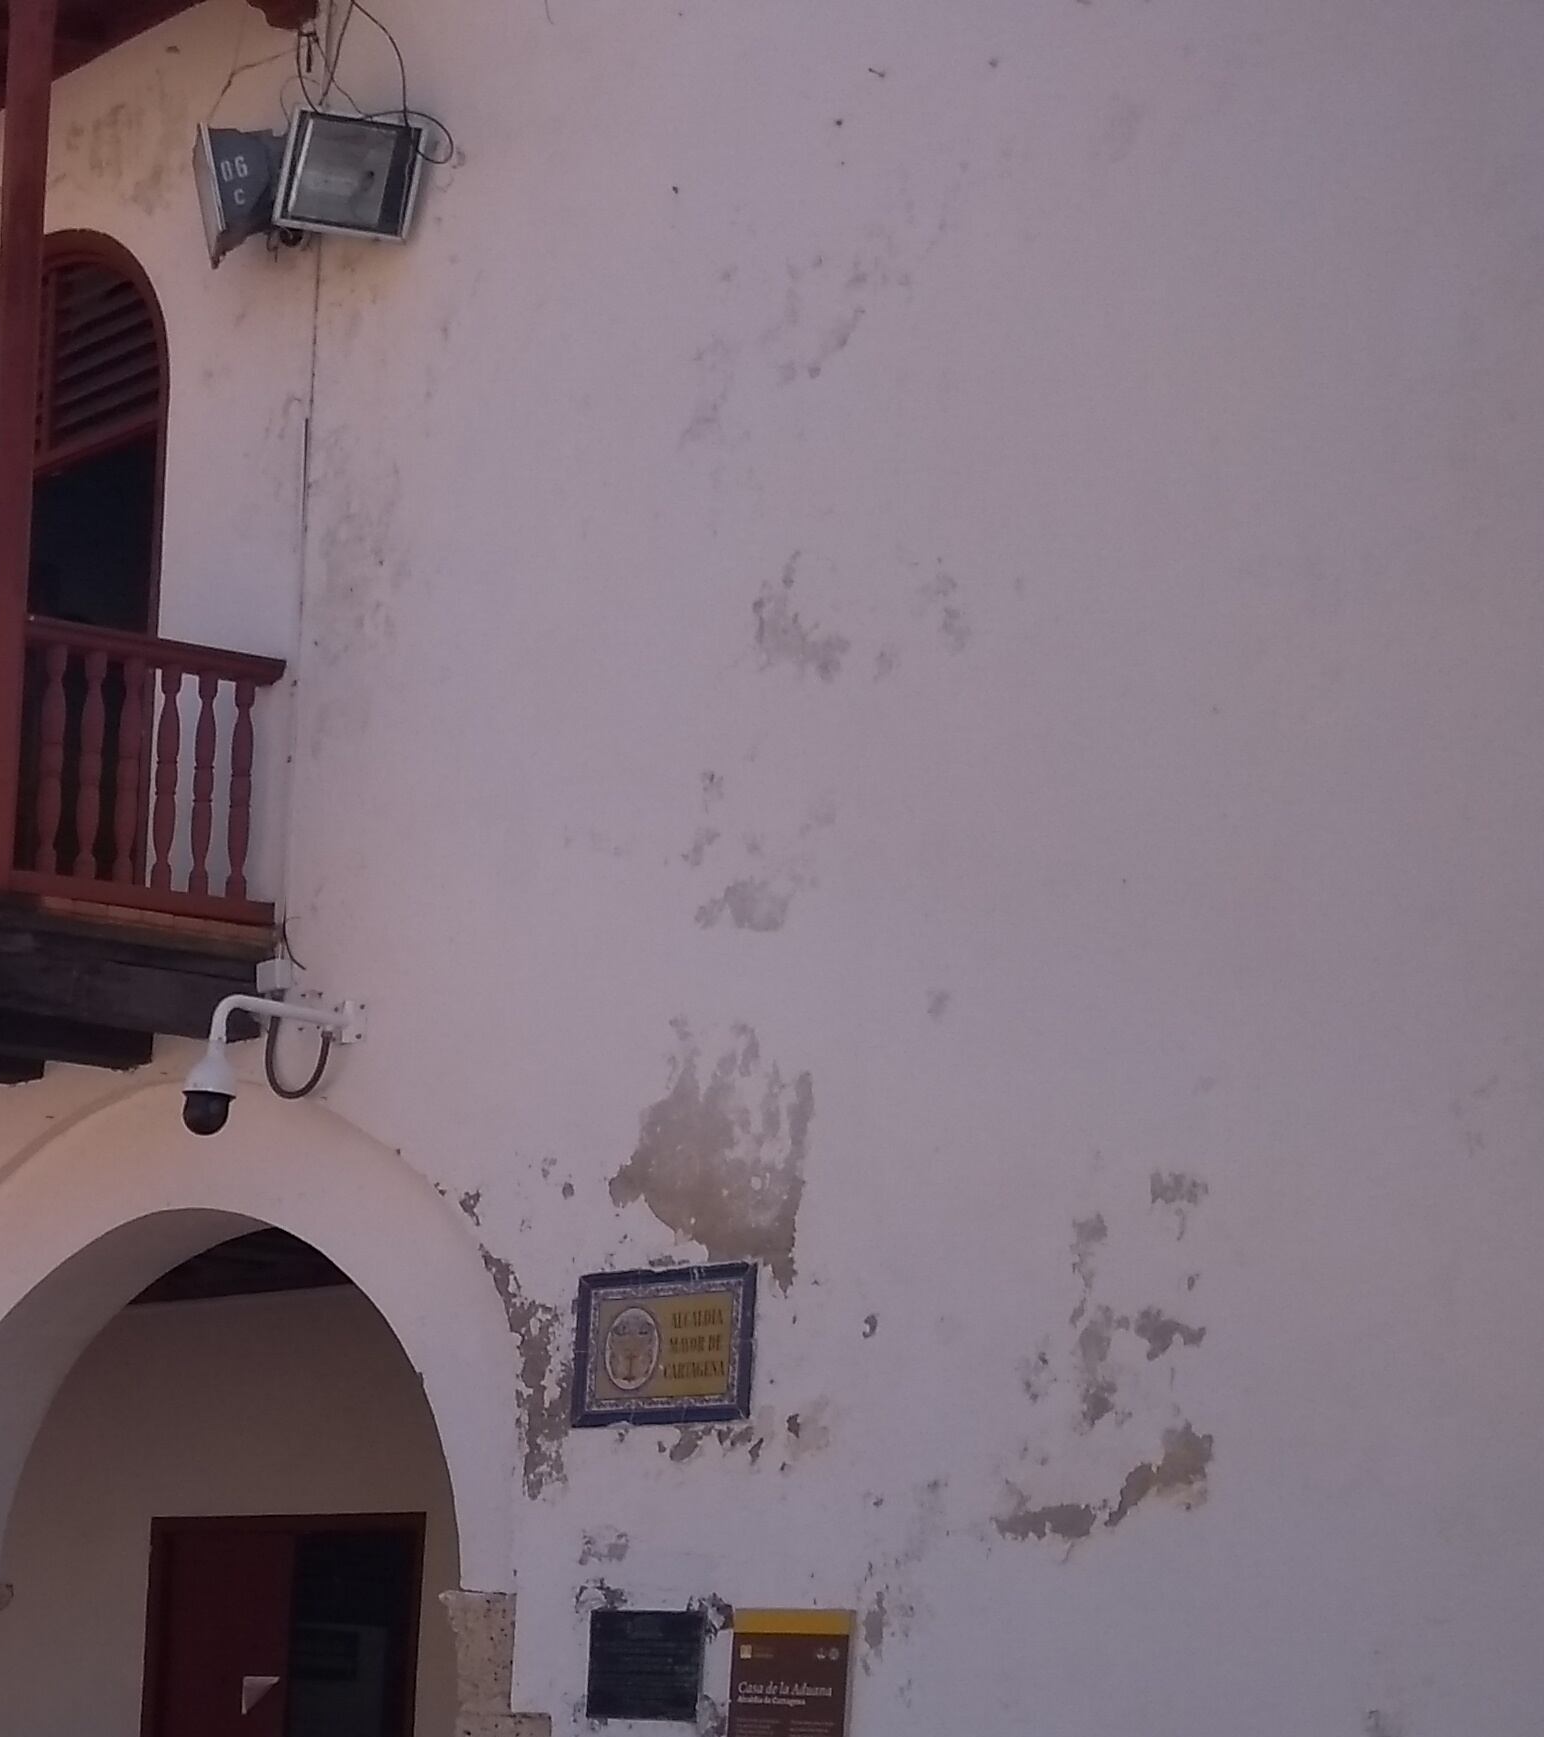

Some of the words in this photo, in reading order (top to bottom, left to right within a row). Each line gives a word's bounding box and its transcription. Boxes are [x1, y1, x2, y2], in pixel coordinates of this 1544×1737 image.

[670, 1335, 705, 1354] MAYOR
[708, 1334, 721, 1352] DE
[663, 1360, 725, 1380] CARTAGENA
[738, 1681, 764, 1694] Casa
[765, 1681, 778, 1695] de
[779, 1682, 790, 1695] la
[791, 1682, 833, 1697] Aduana
[772, 1697, 806, 1707] Cartagena
